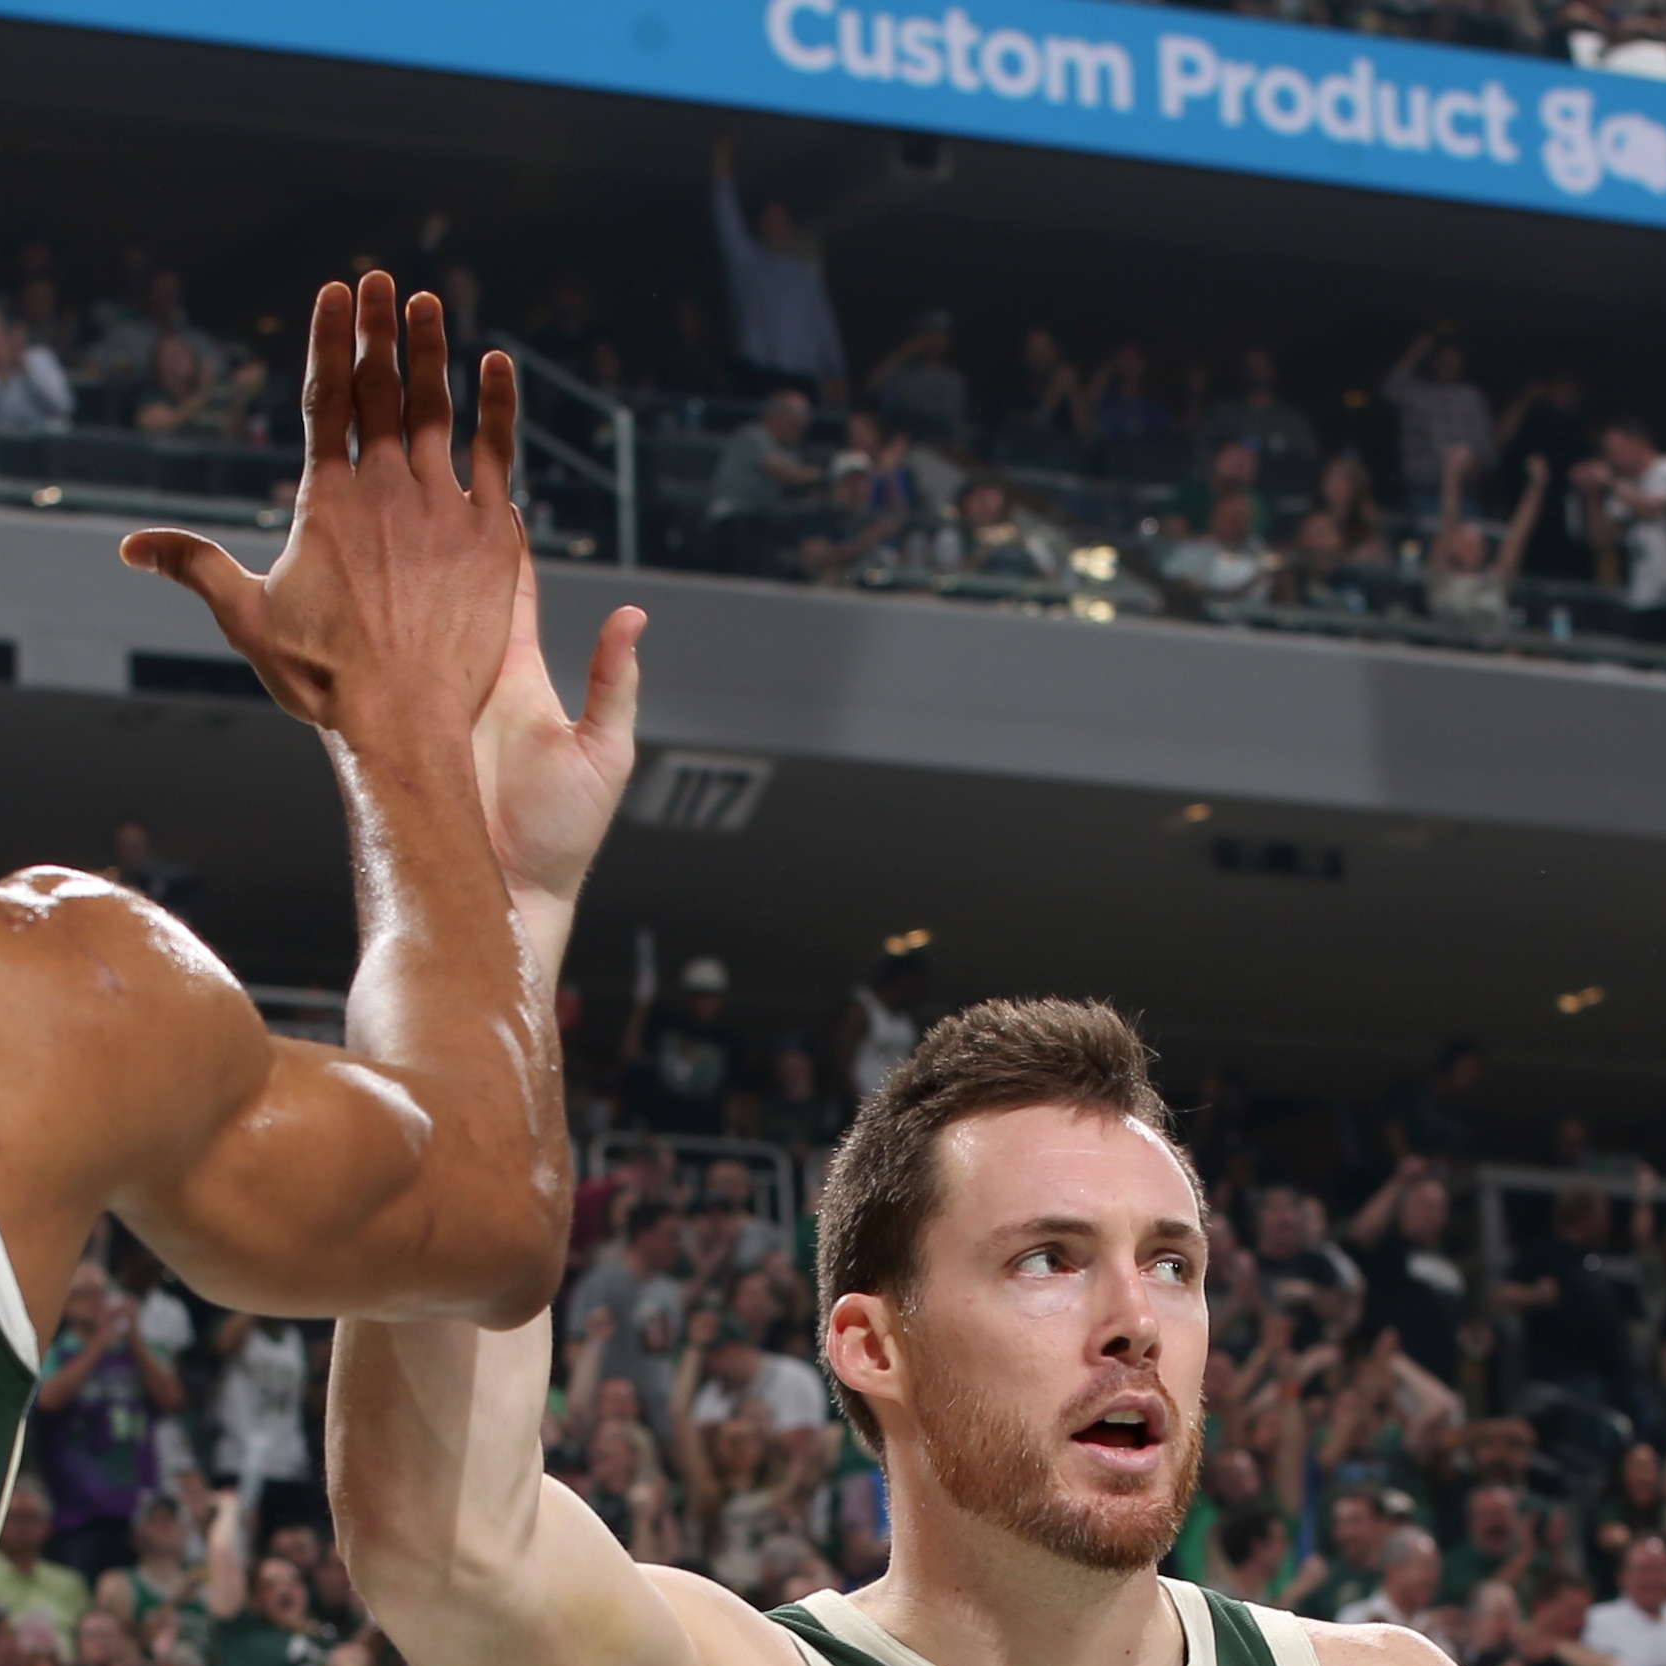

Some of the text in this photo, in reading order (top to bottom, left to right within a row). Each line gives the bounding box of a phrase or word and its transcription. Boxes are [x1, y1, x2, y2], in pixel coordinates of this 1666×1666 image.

[767, 0, 1132, 110] Custom
[1159, 36, 1518, 162] Product
[665, 766, 751, 826] 117
